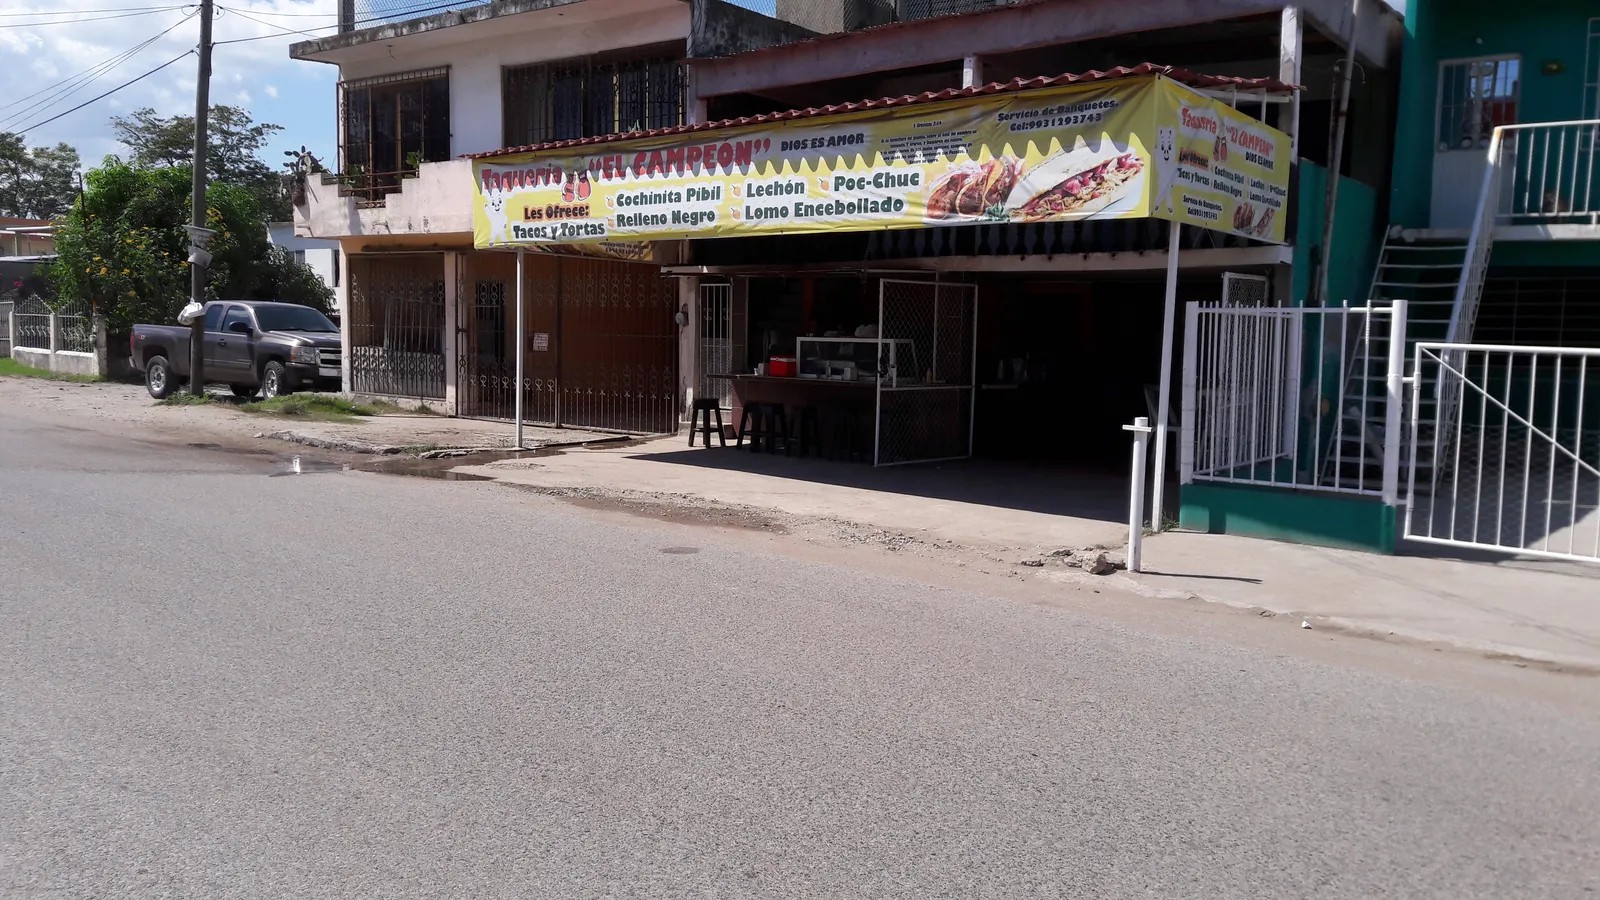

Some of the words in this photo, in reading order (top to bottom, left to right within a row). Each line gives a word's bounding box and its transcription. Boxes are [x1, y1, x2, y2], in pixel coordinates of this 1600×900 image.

[998, 110, 1039, 121] Servicio
[1042, 107, 1054, 115] de
[781, 138, 808, 152] DIOS
[811, 137, 825, 148] ES
[826, 133, 865, 147] AMOR
[746, 180, 805, 198] Lechón
[834, 172, 920, 191] Poc-Chuc
[616, 190, 681, 207] Cochinita
[686, 186, 721, 202] Pibil
[524, 207, 543, 220] Les
[546, 205, 589, 219] Ofrece:
[745, 205, 789, 220] Lomo
[794, 197, 904, 217] Encebollado
[616, 211, 668, 228] Relleno
[671, 210, 716, 226] Negro
[513, 225, 547, 239] Tacos
[551, 226, 559, 240] y
[560, 222, 605, 237] Tortas
